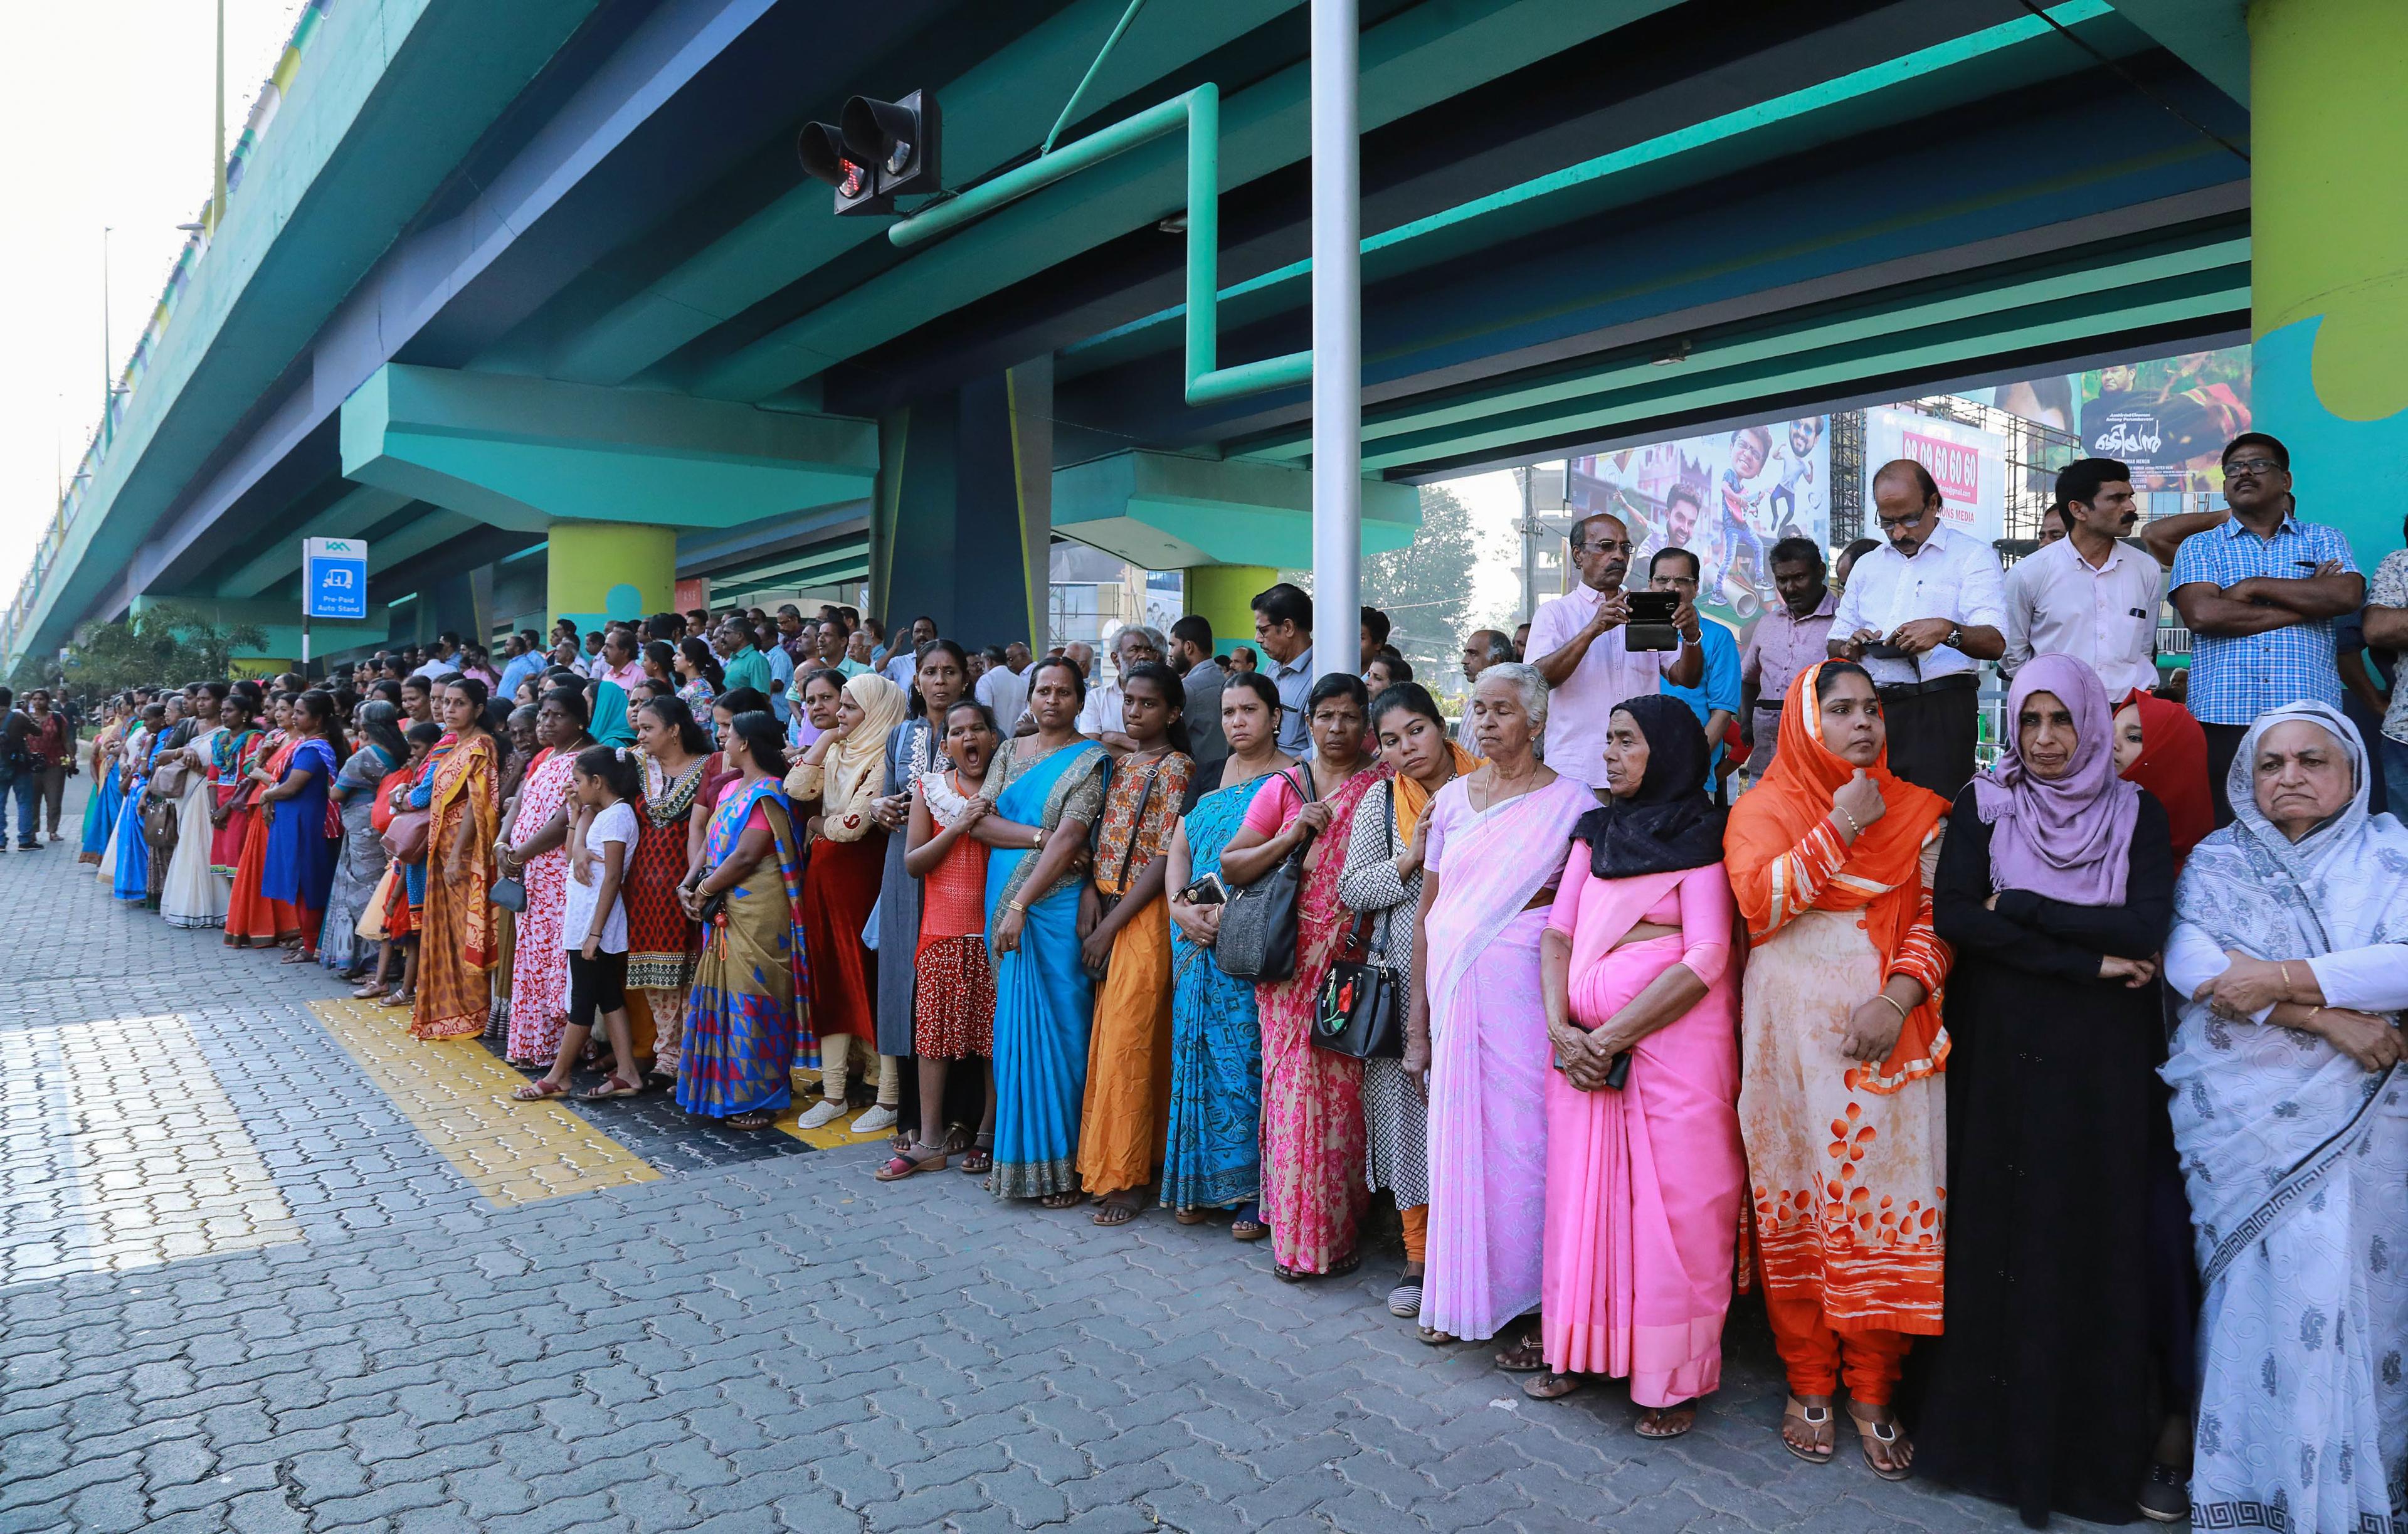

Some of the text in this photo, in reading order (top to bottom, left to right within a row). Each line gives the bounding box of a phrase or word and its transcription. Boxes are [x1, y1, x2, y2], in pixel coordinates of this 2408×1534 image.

[1920, 442, 1933, 475] 09
[1935, 445, 1948, 481] 60
[1950, 449, 1962, 485] 60
[1964, 452, 1976, 488] 60
[1956, 509, 1975, 524] MEDIA
